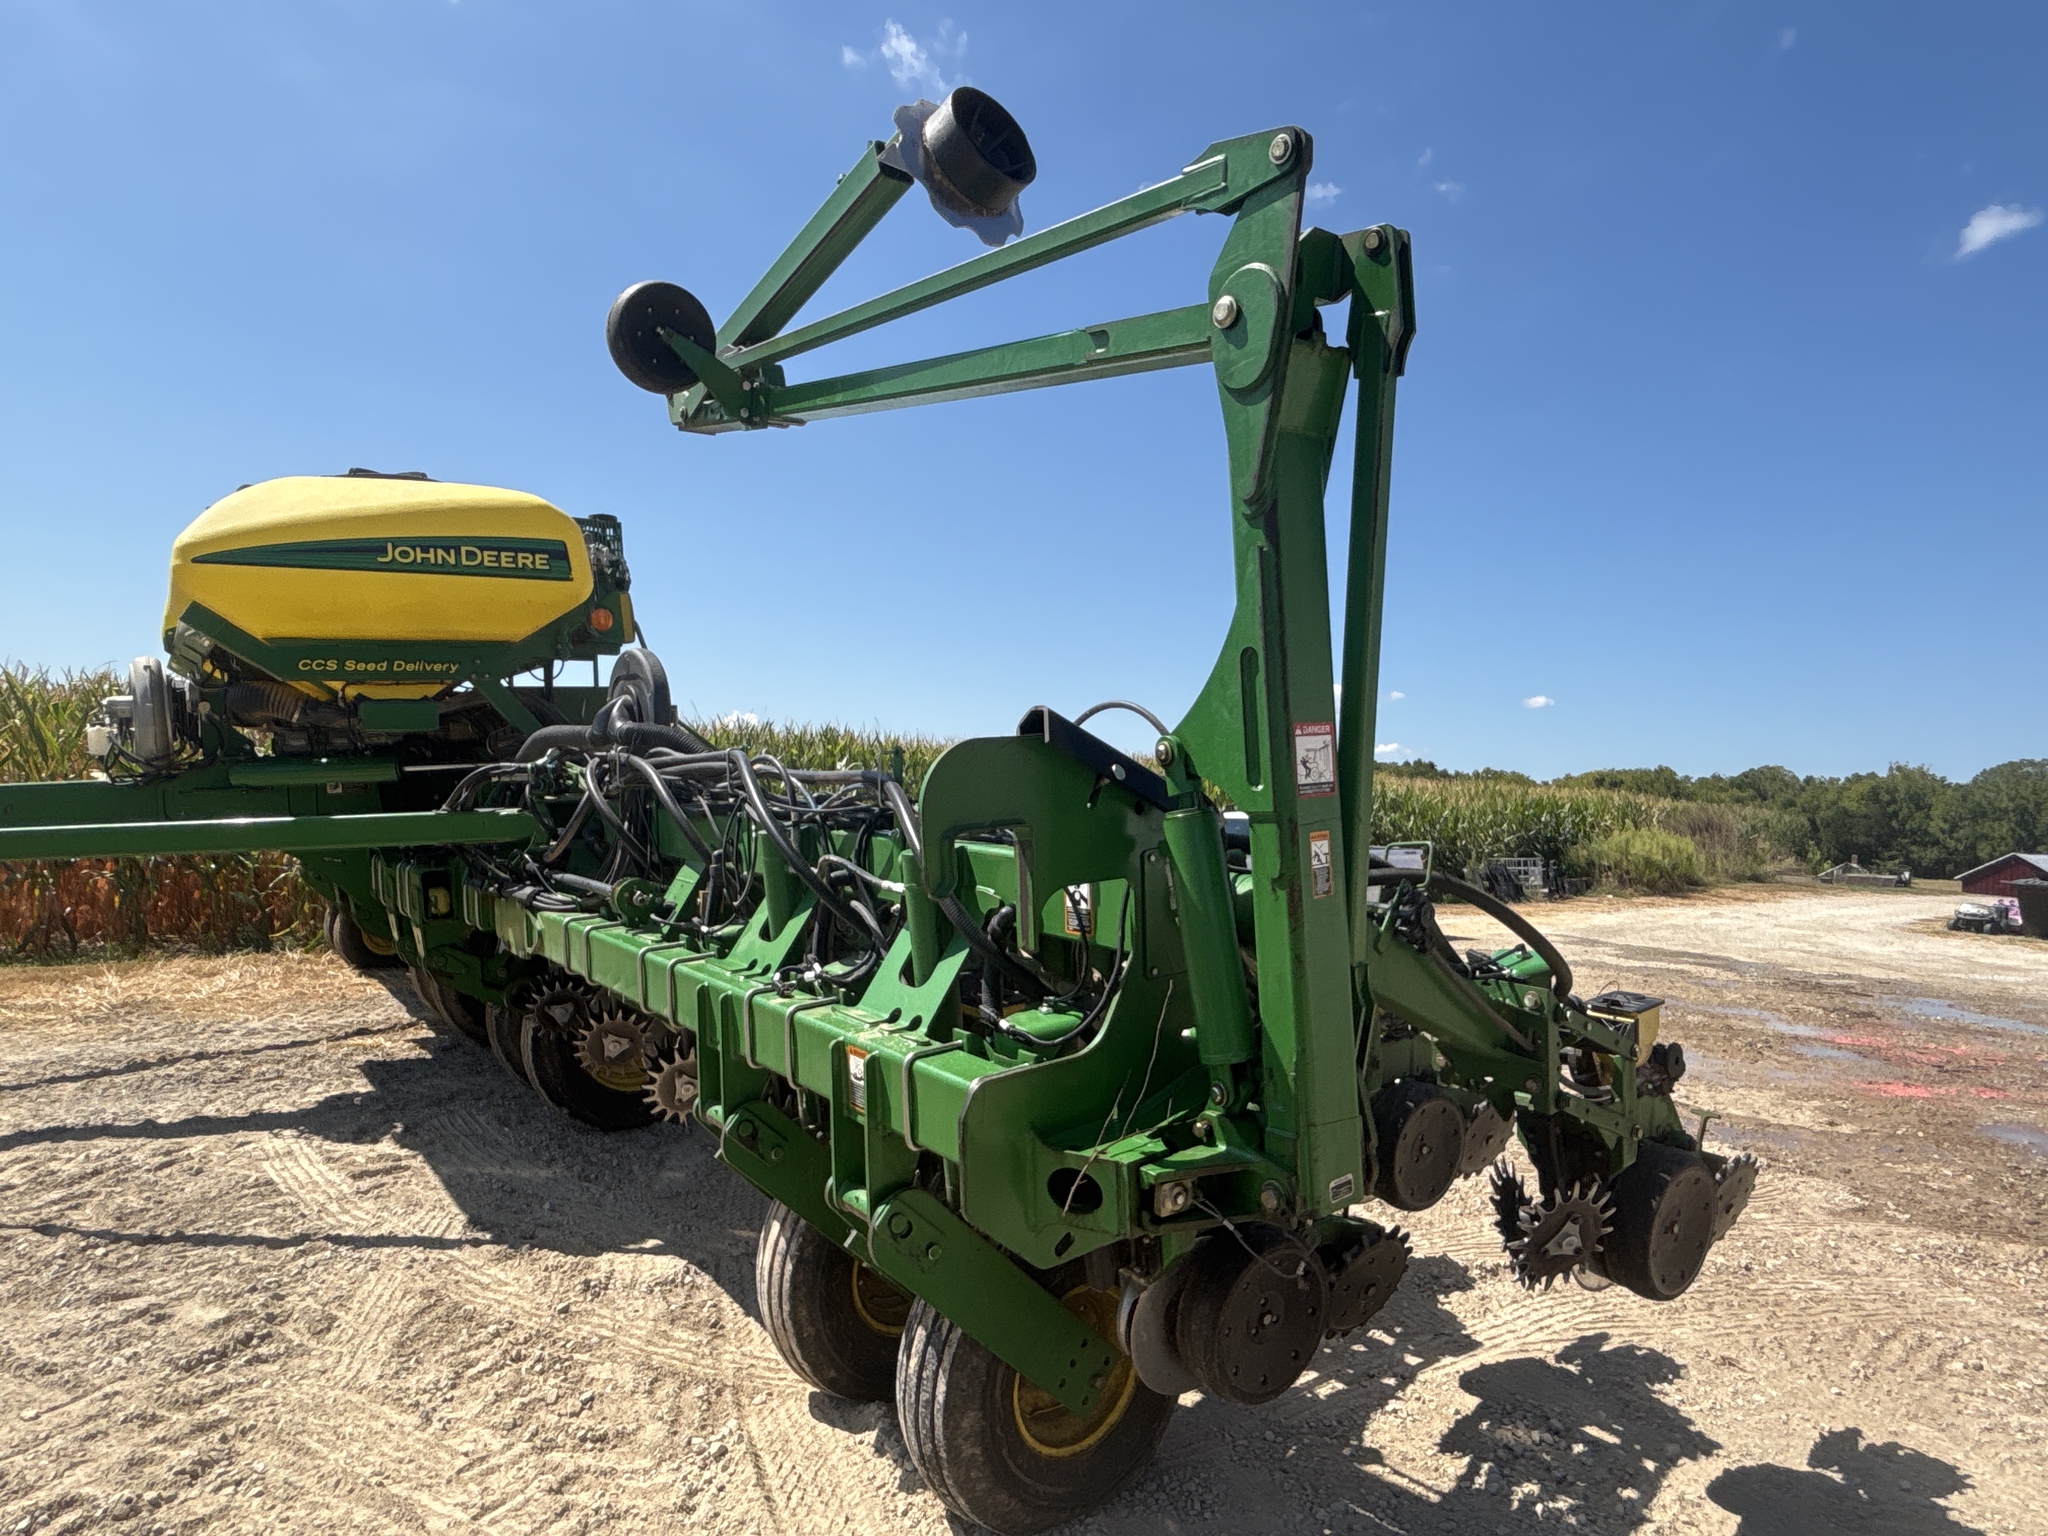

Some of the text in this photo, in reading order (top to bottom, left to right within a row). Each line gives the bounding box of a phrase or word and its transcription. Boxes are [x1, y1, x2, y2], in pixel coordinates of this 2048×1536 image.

[377, 542, 550, 570] JOHN DEERE
[298, 659, 460, 674] CCS Seed Delivery
[1302, 724, 1330, 734] DANGER
